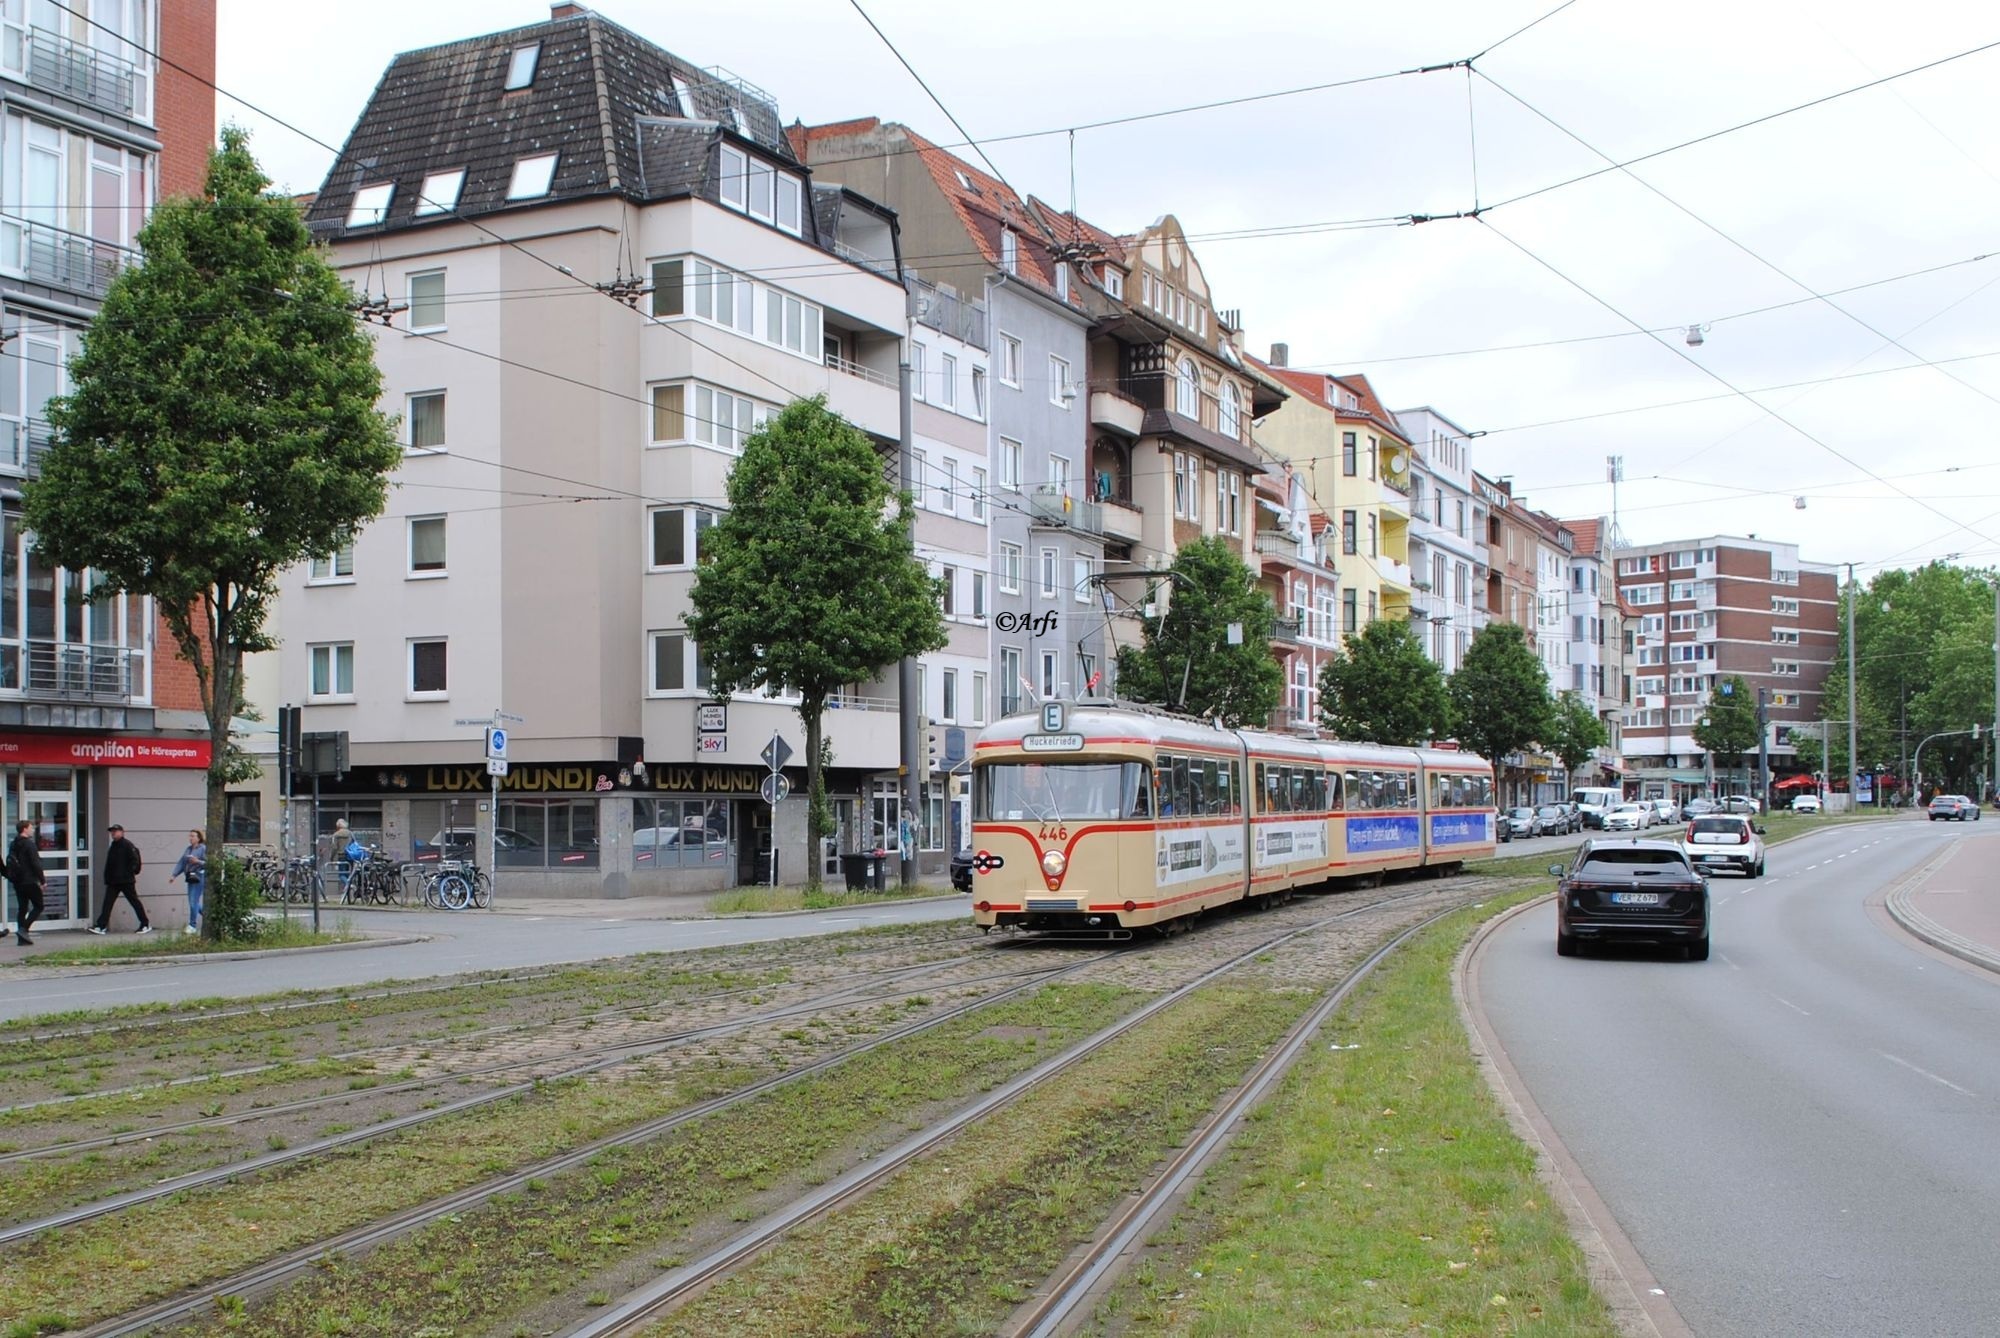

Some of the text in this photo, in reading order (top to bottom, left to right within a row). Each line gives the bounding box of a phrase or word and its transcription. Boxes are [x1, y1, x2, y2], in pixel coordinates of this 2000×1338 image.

[1047, 705, 1059, 728] E
[71, 741, 134, 761] amplifon
[137, 745, 197, 758] Die Hörexperten
[704, 738, 722, 751] sky
[427, 767, 484, 790] LUX
[499, 766, 593, 792] MUNDI
[655, 767, 759, 792] LUX MUNDI
[1038, 827, 1068, 841] 446
